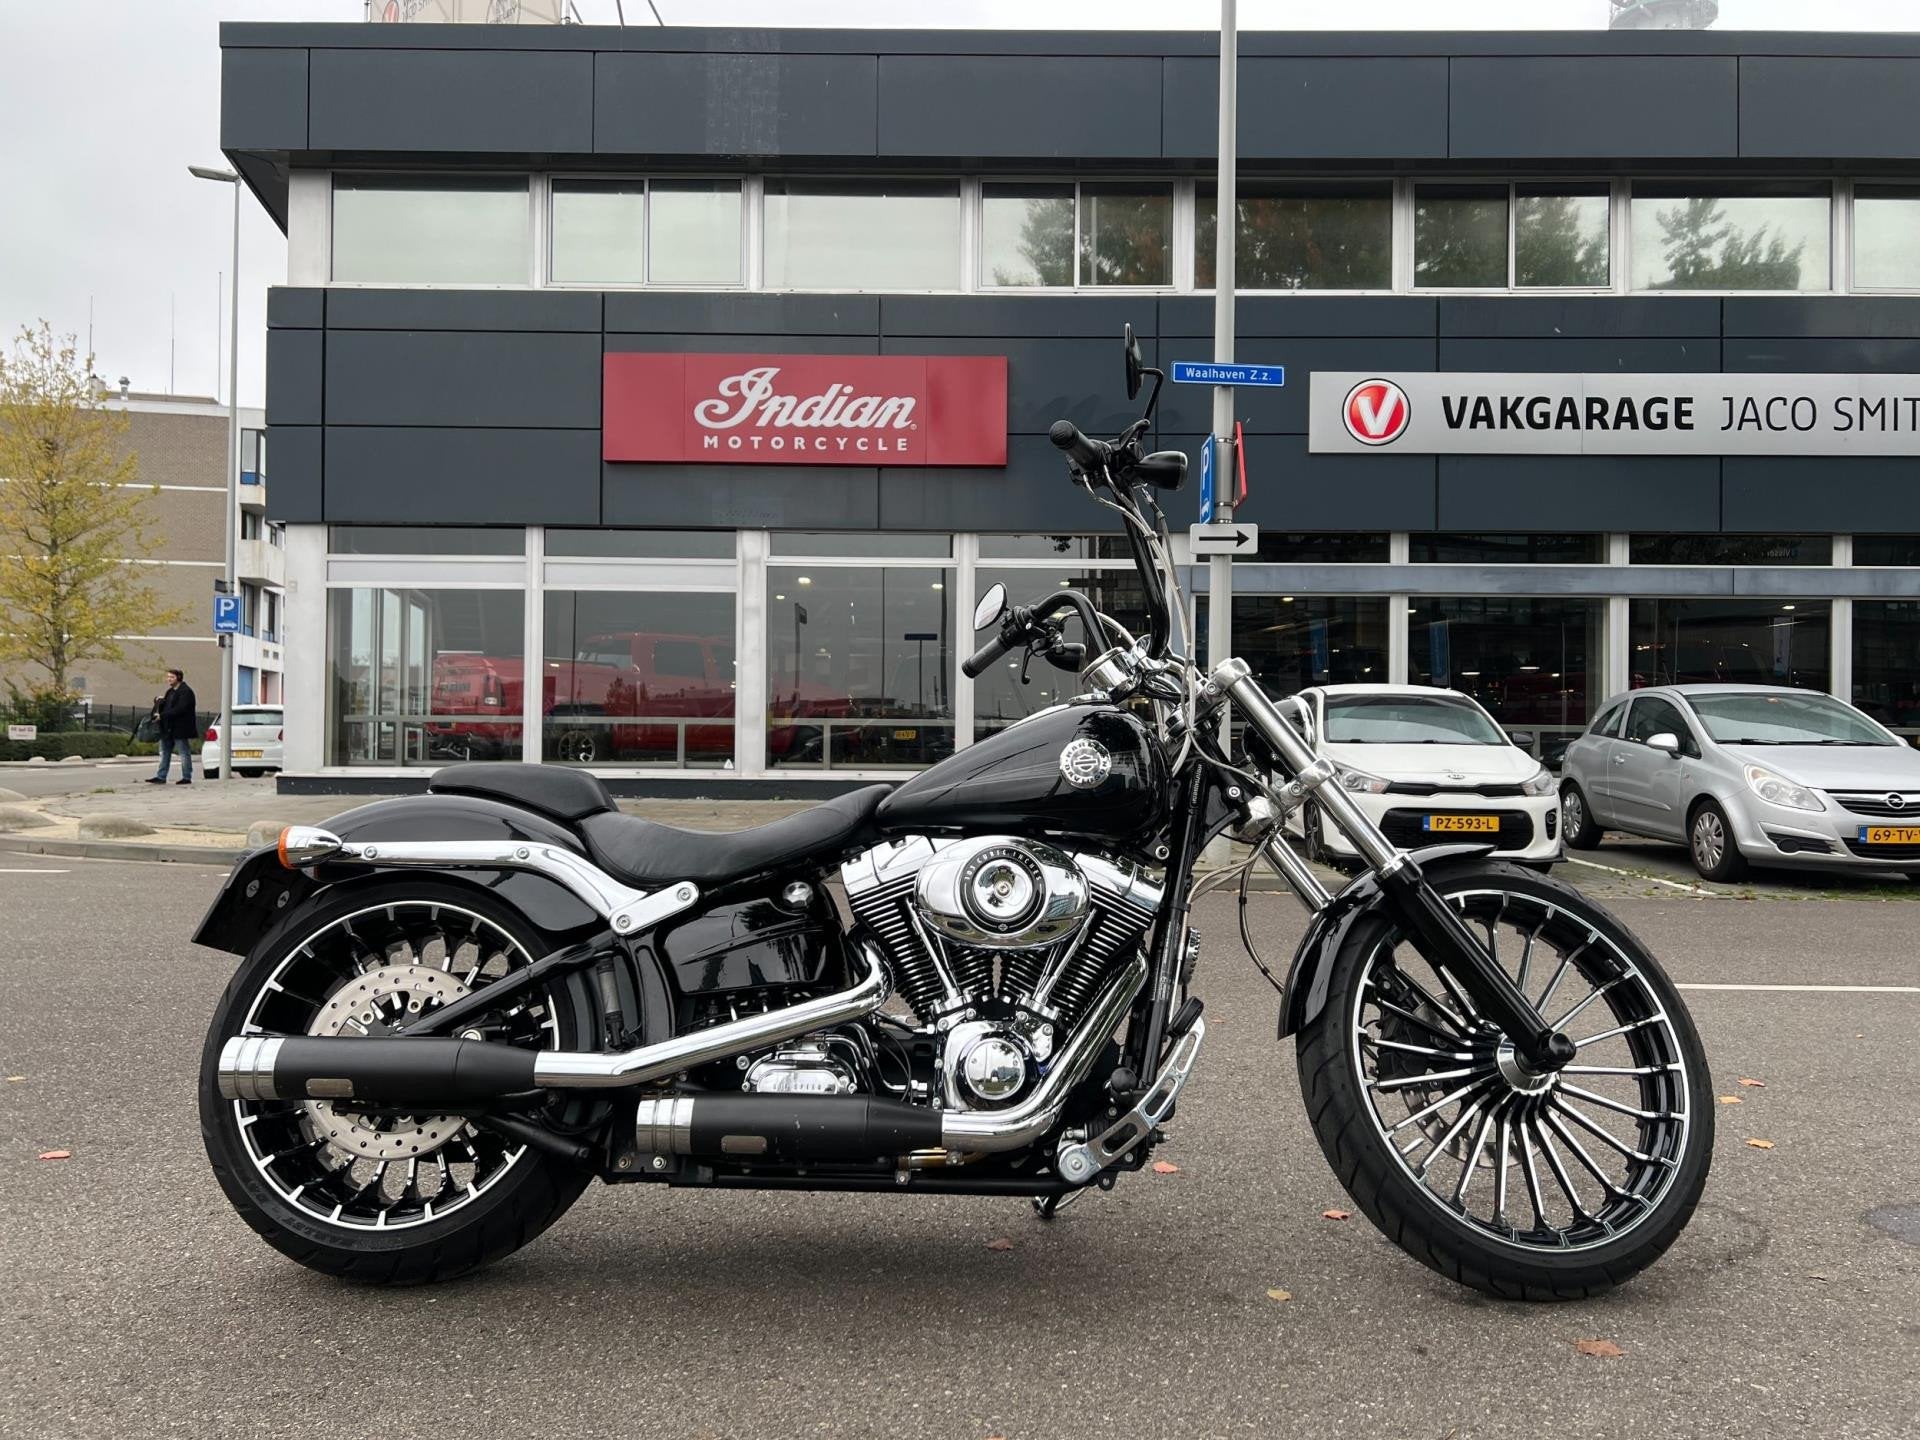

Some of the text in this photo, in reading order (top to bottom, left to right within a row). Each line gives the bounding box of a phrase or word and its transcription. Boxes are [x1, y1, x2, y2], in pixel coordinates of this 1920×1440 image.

[1185, 367, 1272, 381] Waalhaven Z.z.
[694, 367, 916, 429] Indian
[1441, 395, 1920, 432] VAKGARAGE JACO SMIT
[703, 435, 907, 451] MOTORCYCLE
[220, 599, 235, 617] P
[1436, 817, 1493, 829] PZ-593-L
[1873, 829, 1920, 841] 69-TV-
[976, 849, 1007, 863] CUBIC
[1013, 851, 1042, 881] INCHES
